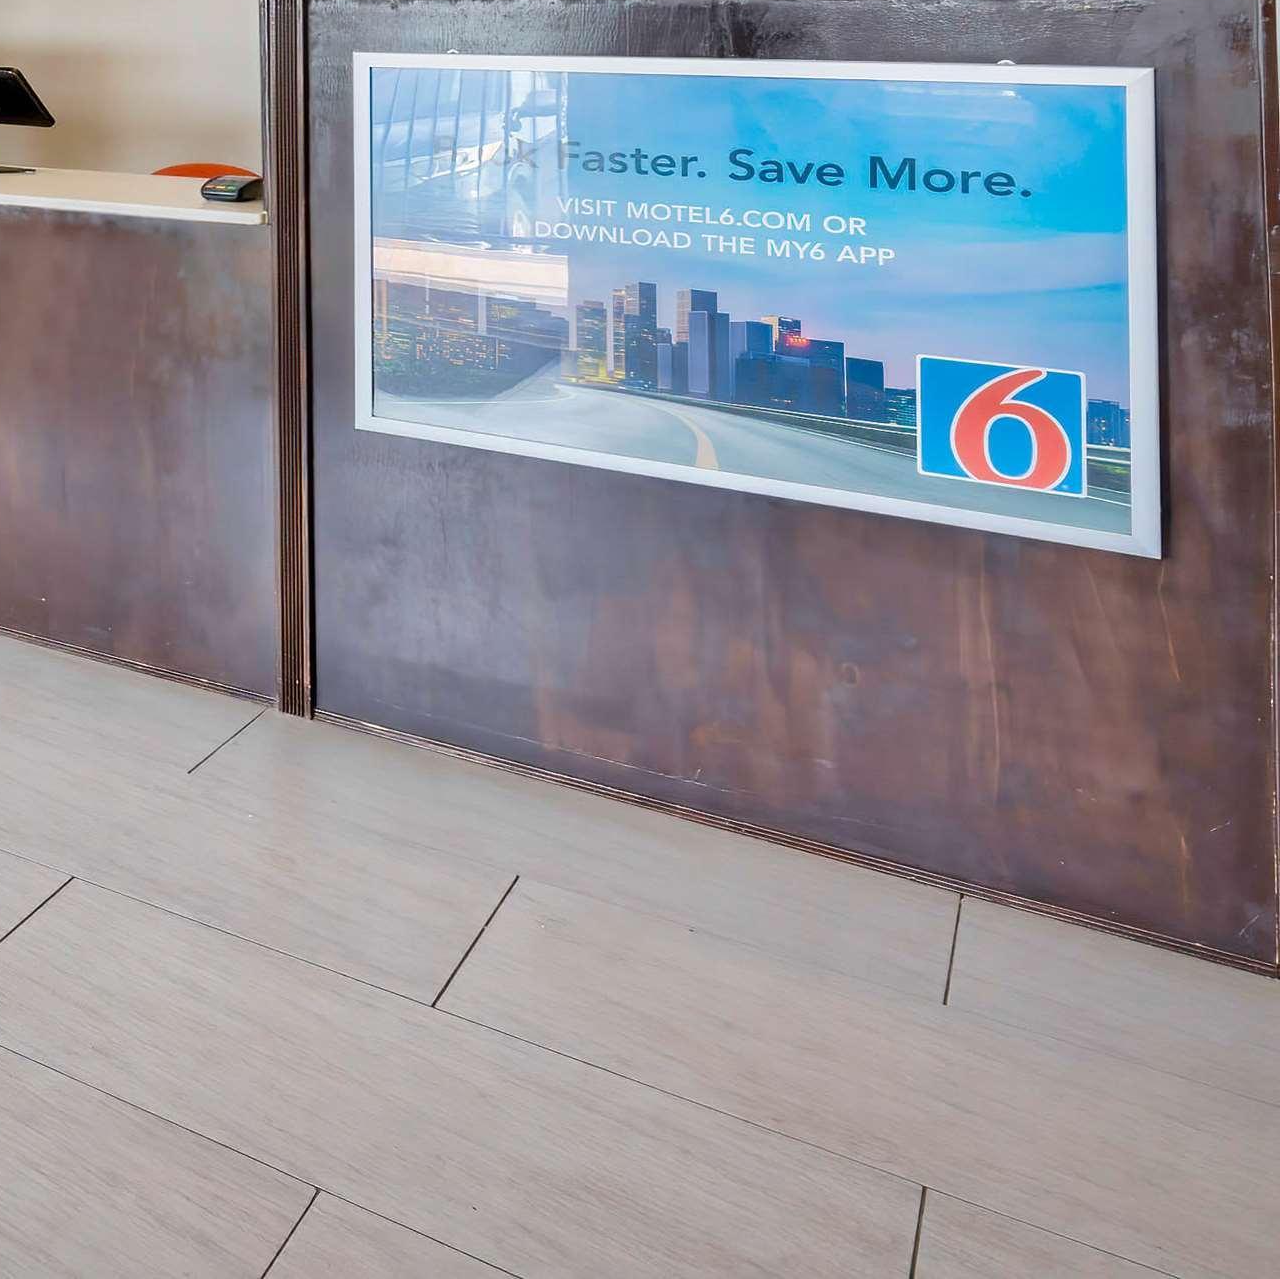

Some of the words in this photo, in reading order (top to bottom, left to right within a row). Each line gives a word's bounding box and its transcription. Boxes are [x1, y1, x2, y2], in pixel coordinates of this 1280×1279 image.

[557, 140, 707, 179] Faster.
[728, 148, 845, 187] Save
[868, 155, 1033, 198] More.
[556, 195, 617, 217] VISIT
[627, 201, 811, 232] MOTEL6.COM
[823, 214, 867, 236] OR
[535, 220, 691, 249] DOWNLOAD
[701, 234, 756, 255] THE
[767, 238, 826, 261] MY6
[837, 244, 896, 267] APP
[950, 368, 1072, 492] 6
